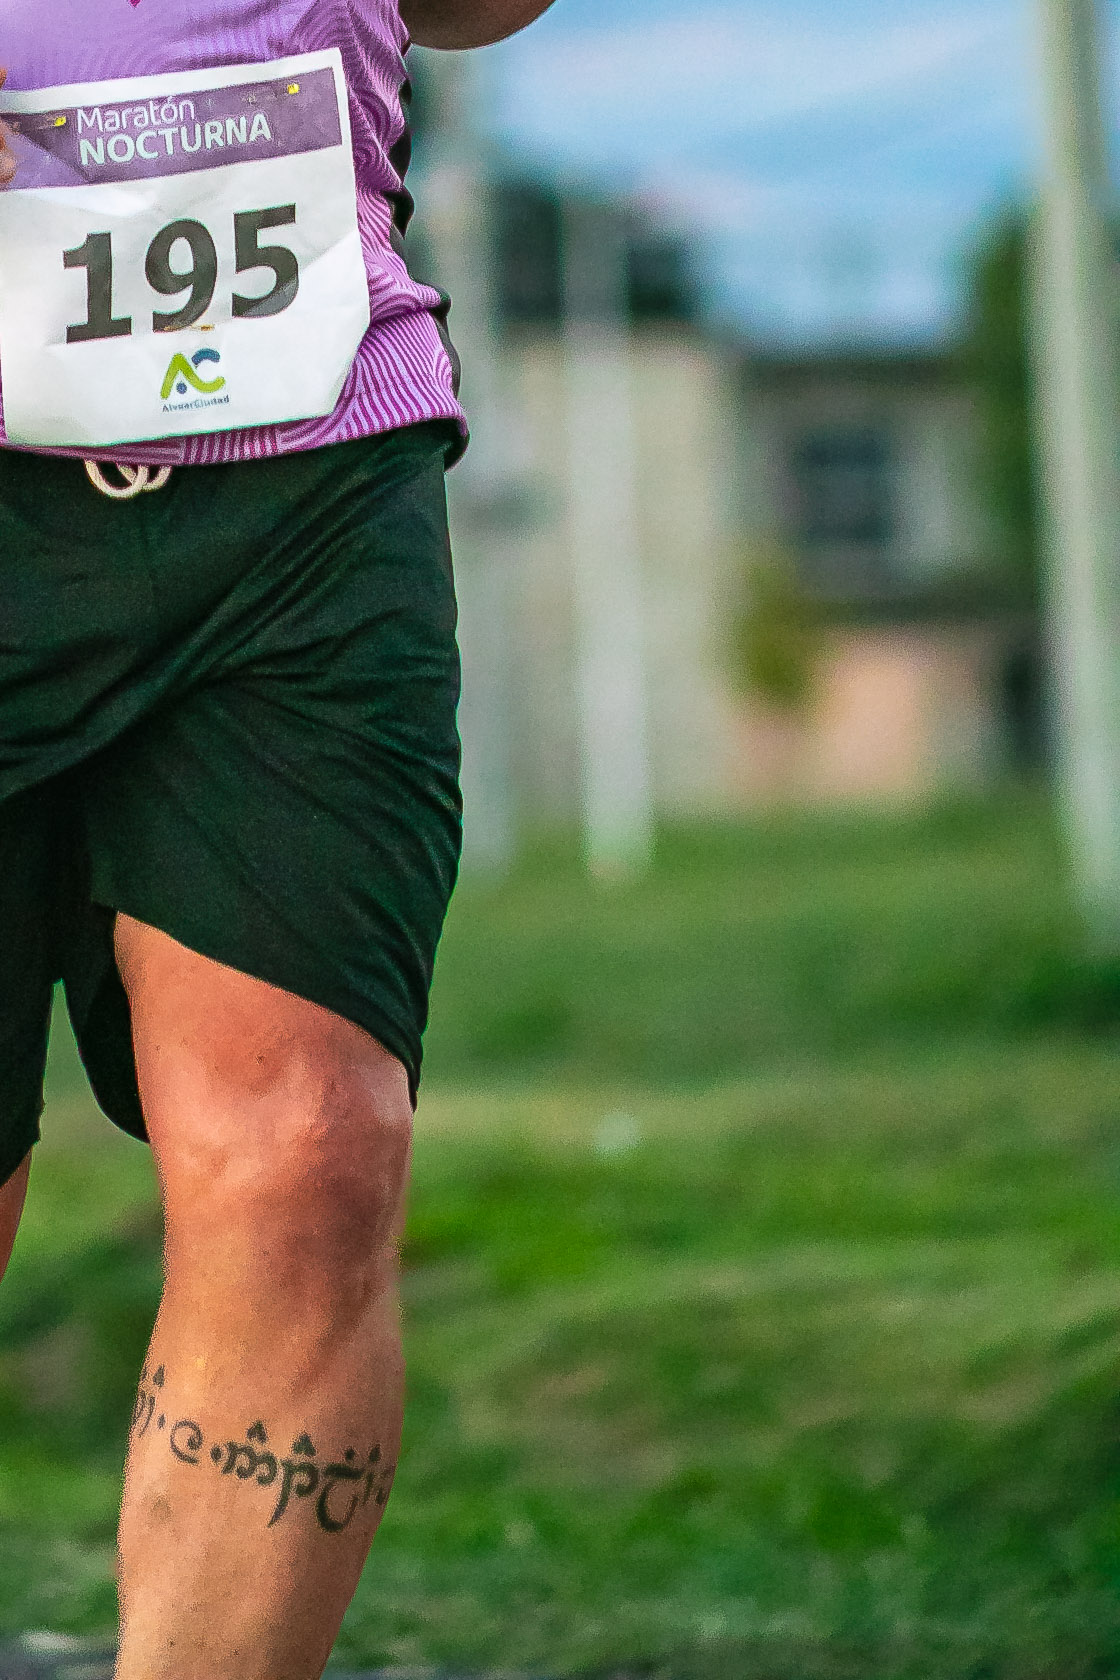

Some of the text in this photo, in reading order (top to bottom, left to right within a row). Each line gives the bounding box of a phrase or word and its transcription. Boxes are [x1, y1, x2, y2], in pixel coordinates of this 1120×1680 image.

[77, 95, 195, 134] Maratón
[79, 112, 272, 166] NOCTURNA
[62, 202, 299, 345] 195
